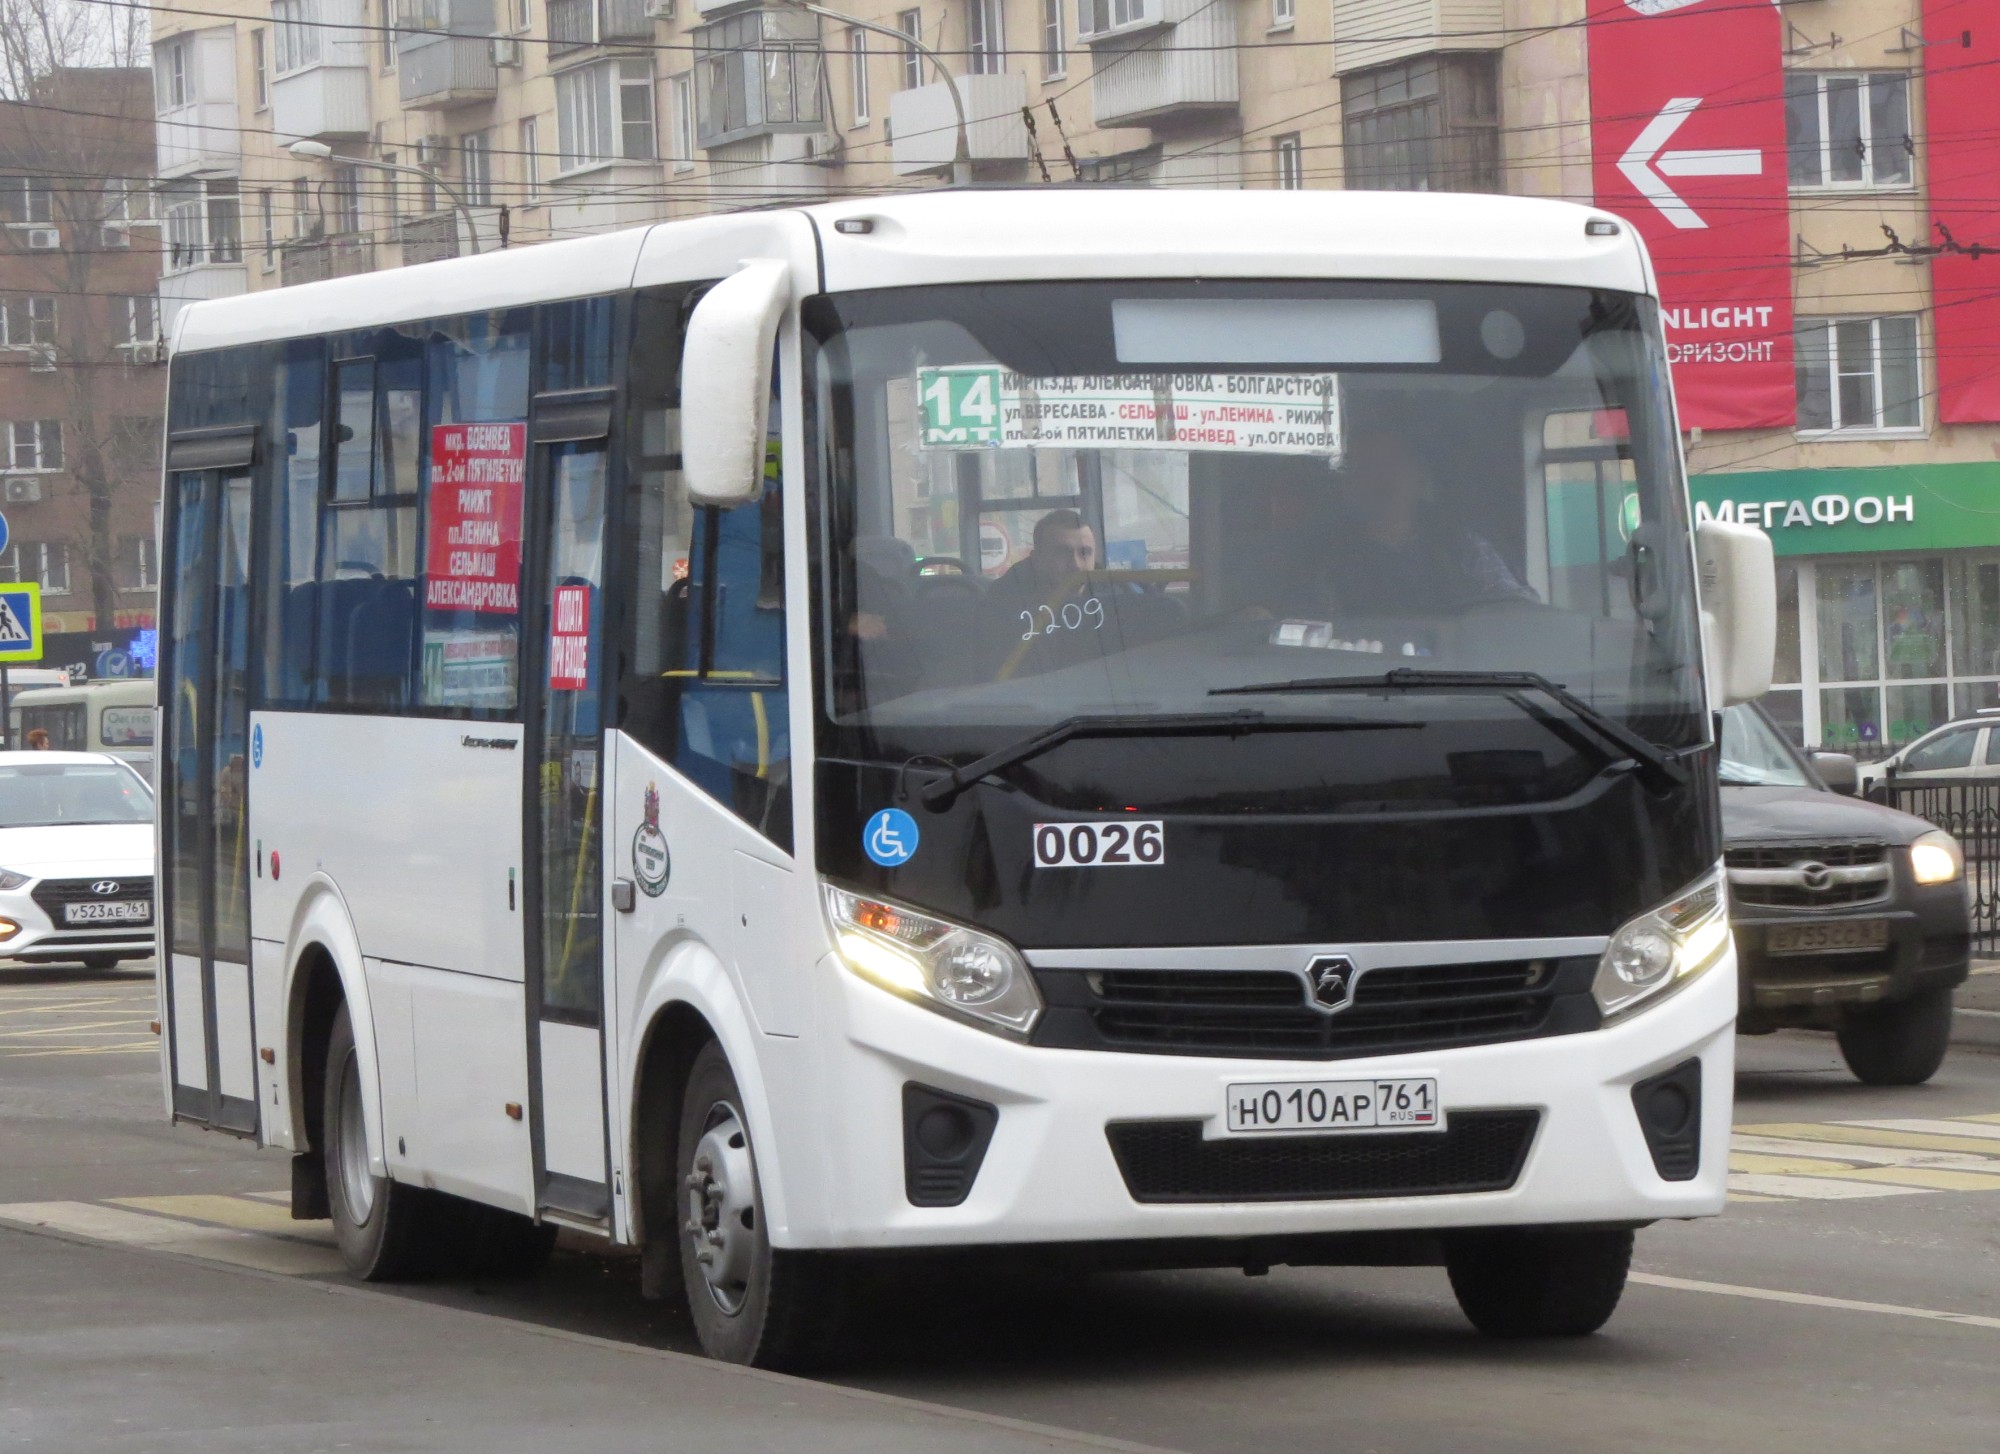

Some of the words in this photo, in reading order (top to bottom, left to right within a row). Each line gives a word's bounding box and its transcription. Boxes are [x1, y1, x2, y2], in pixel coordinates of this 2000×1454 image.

[1227, 376, 1333, 396] БОЛГАРСТРОЙ
[925, 375, 997, 426] 14
[1005, 404, 1106, 422] ул.ВЕРЕСАЕВА
[1201, 406, 1274, 424] ул.ЛЕНИНА
[1287, 409, 1334, 425] РИИЖТ
[467, 426, 511, 455] ВОЕНВЕД
[1033, 427, 1062, 440] 2-ой
[1067, 426, 1154, 440] ПЯТИЛЕТКИ
[1248, 431, 1335, 446] ул.ОГАНОВА
[447, 459, 466, 482] 2-ой
[467, 458, 523, 482] ПЯТИЛЕТКИ
[458, 489, 492, 513] РИИЖТ
[450, 552, 496, 577] СЕЛЬМАШ
[427, 580, 518, 610] АЛЕКСАНДРОВКА
[1020, 598, 1104, 640] 2209
[1036, 823, 1162, 864] 0026
[125, 902, 145, 913] 761
[1239, 1088, 1370, 1125] Н010АР
[1378, 1083, 1429, 1111] 761
[1389, 1111, 1414, 1121] RUS
